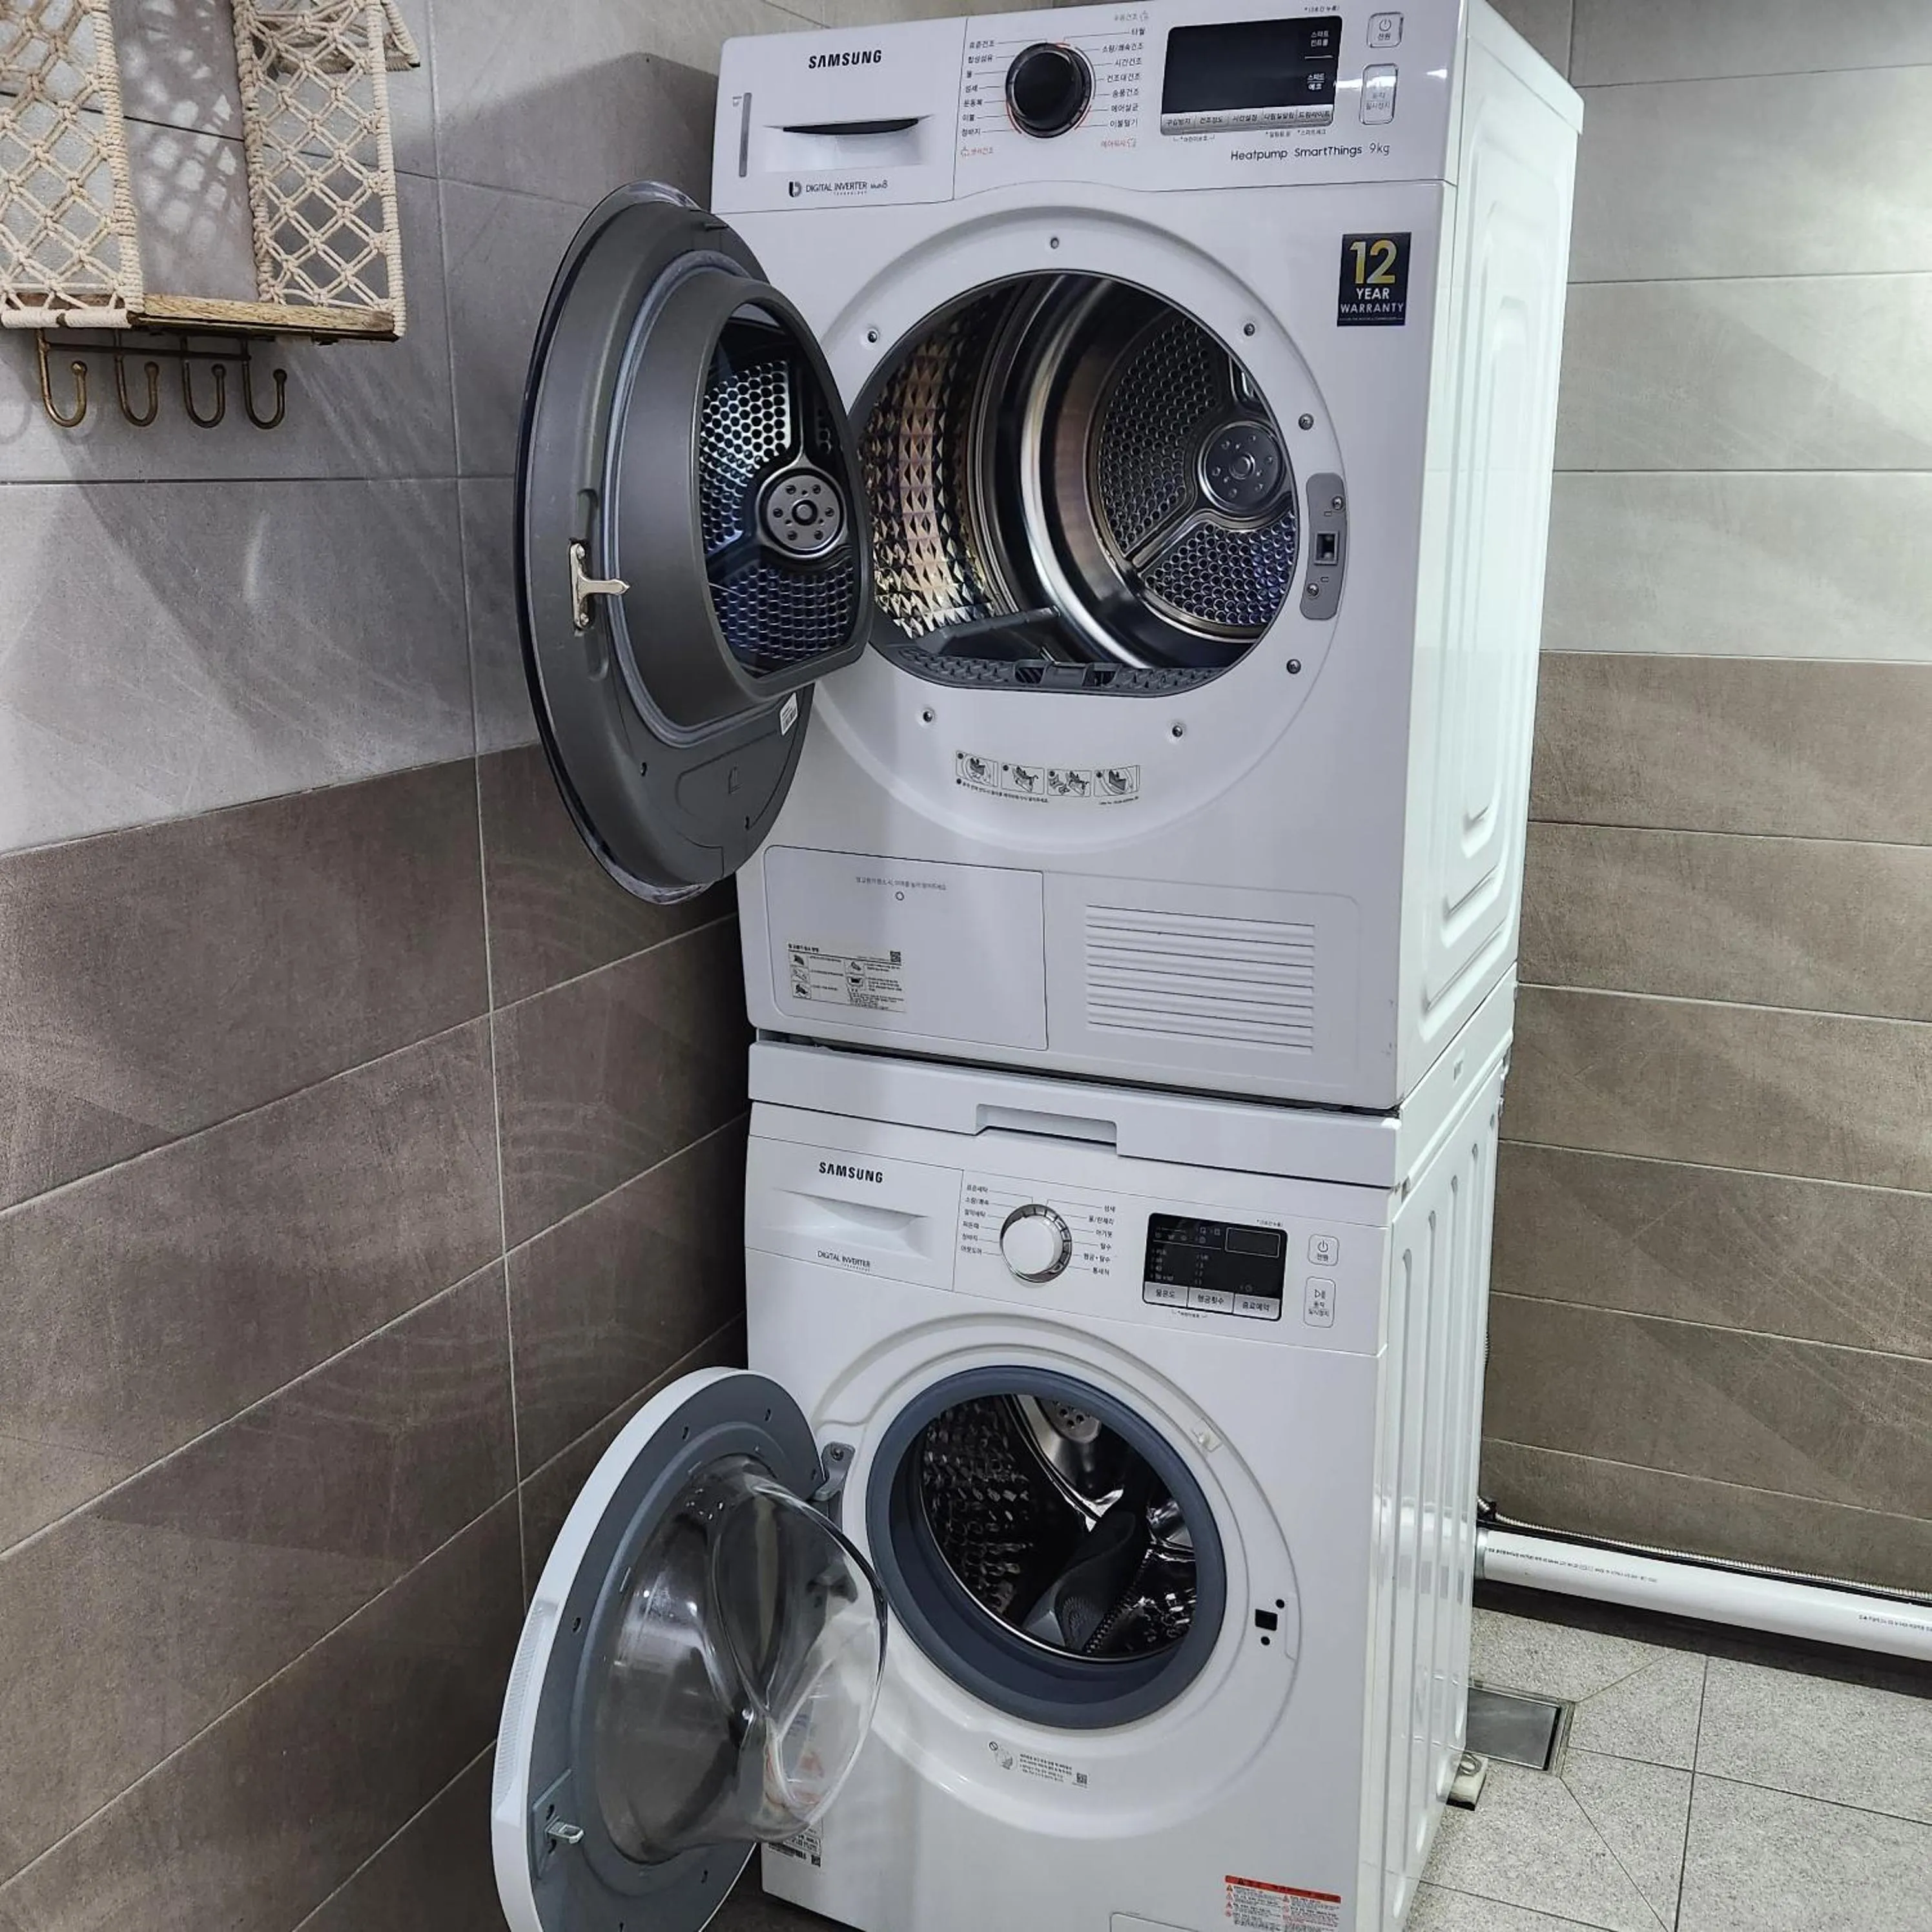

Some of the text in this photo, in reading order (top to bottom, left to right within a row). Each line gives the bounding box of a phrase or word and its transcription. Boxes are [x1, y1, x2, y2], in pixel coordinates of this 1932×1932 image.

[808, 50, 882, 69] SAMSUNG
[1115, 57, 1142, 67] 시간건조
[1107, 72, 1140, 83] 건조대건조
[1112, 88, 1139, 98] 송풍건조
[1111, 103, 1138, 113] 에어살균
[1231, 143, 1390, 161] Heatpump SmartThings 9kg
[806, 183, 832, 192] DIGITAL
[834, 181, 867, 190] INVERTER
[1350, 239, 1397, 284] 12
[1357, 287, 1390, 300] YEAR
[1341, 302, 1404, 313] WARRANTY
[819, 1162, 883, 1184] SAMSUNG
[1100, 1242, 1111, 1251] 탈수
[817, 1250, 839, 1262] DIGITAL
[842, 1255, 870, 1268] INVERTER
